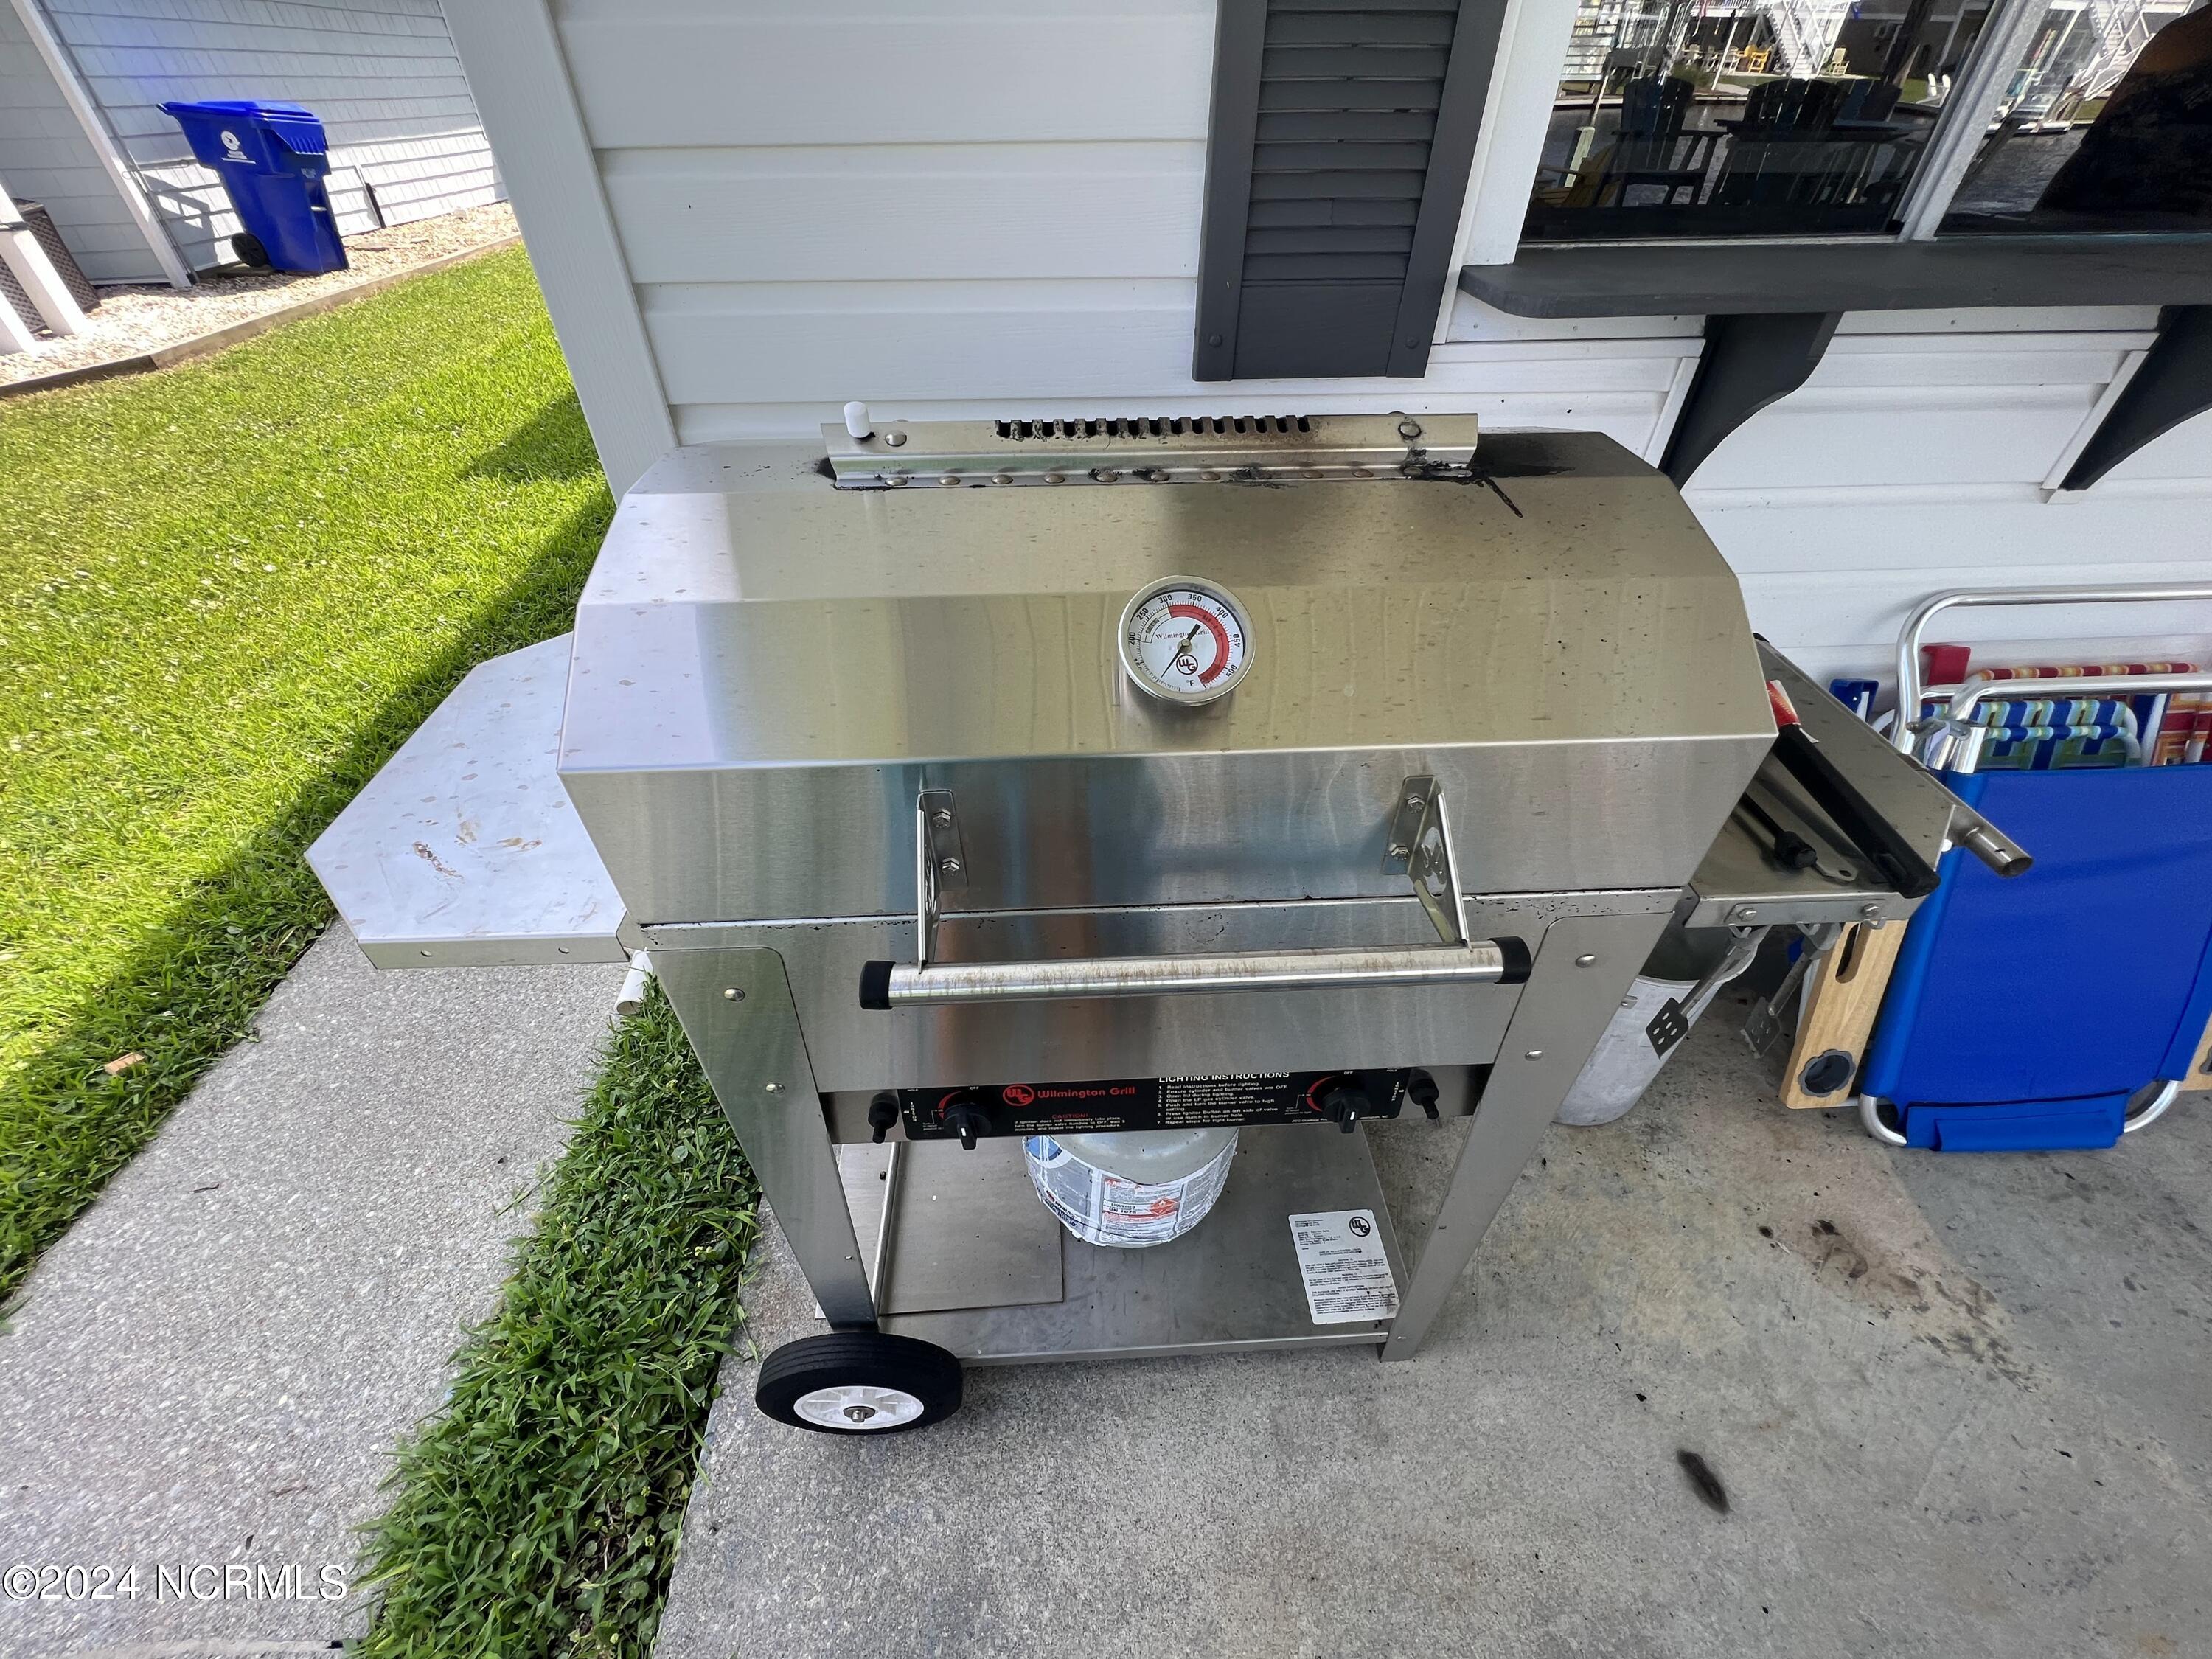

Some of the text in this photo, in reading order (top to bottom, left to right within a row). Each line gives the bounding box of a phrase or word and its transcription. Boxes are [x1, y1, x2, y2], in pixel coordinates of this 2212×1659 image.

[1158, 594, 1172, 604] 300
[1188, 594, 1202, 602] 350
[1136, 608, 1149, 620] 250
[1216, 606, 1228, 619] 400
[1155, 631, 1191, 640] Wilmingto
[1233, 633, 1241, 647] 450
[1226, 664, 1237, 678] 500
[1037, 1086, 1135, 1099] Wilmington Grill
